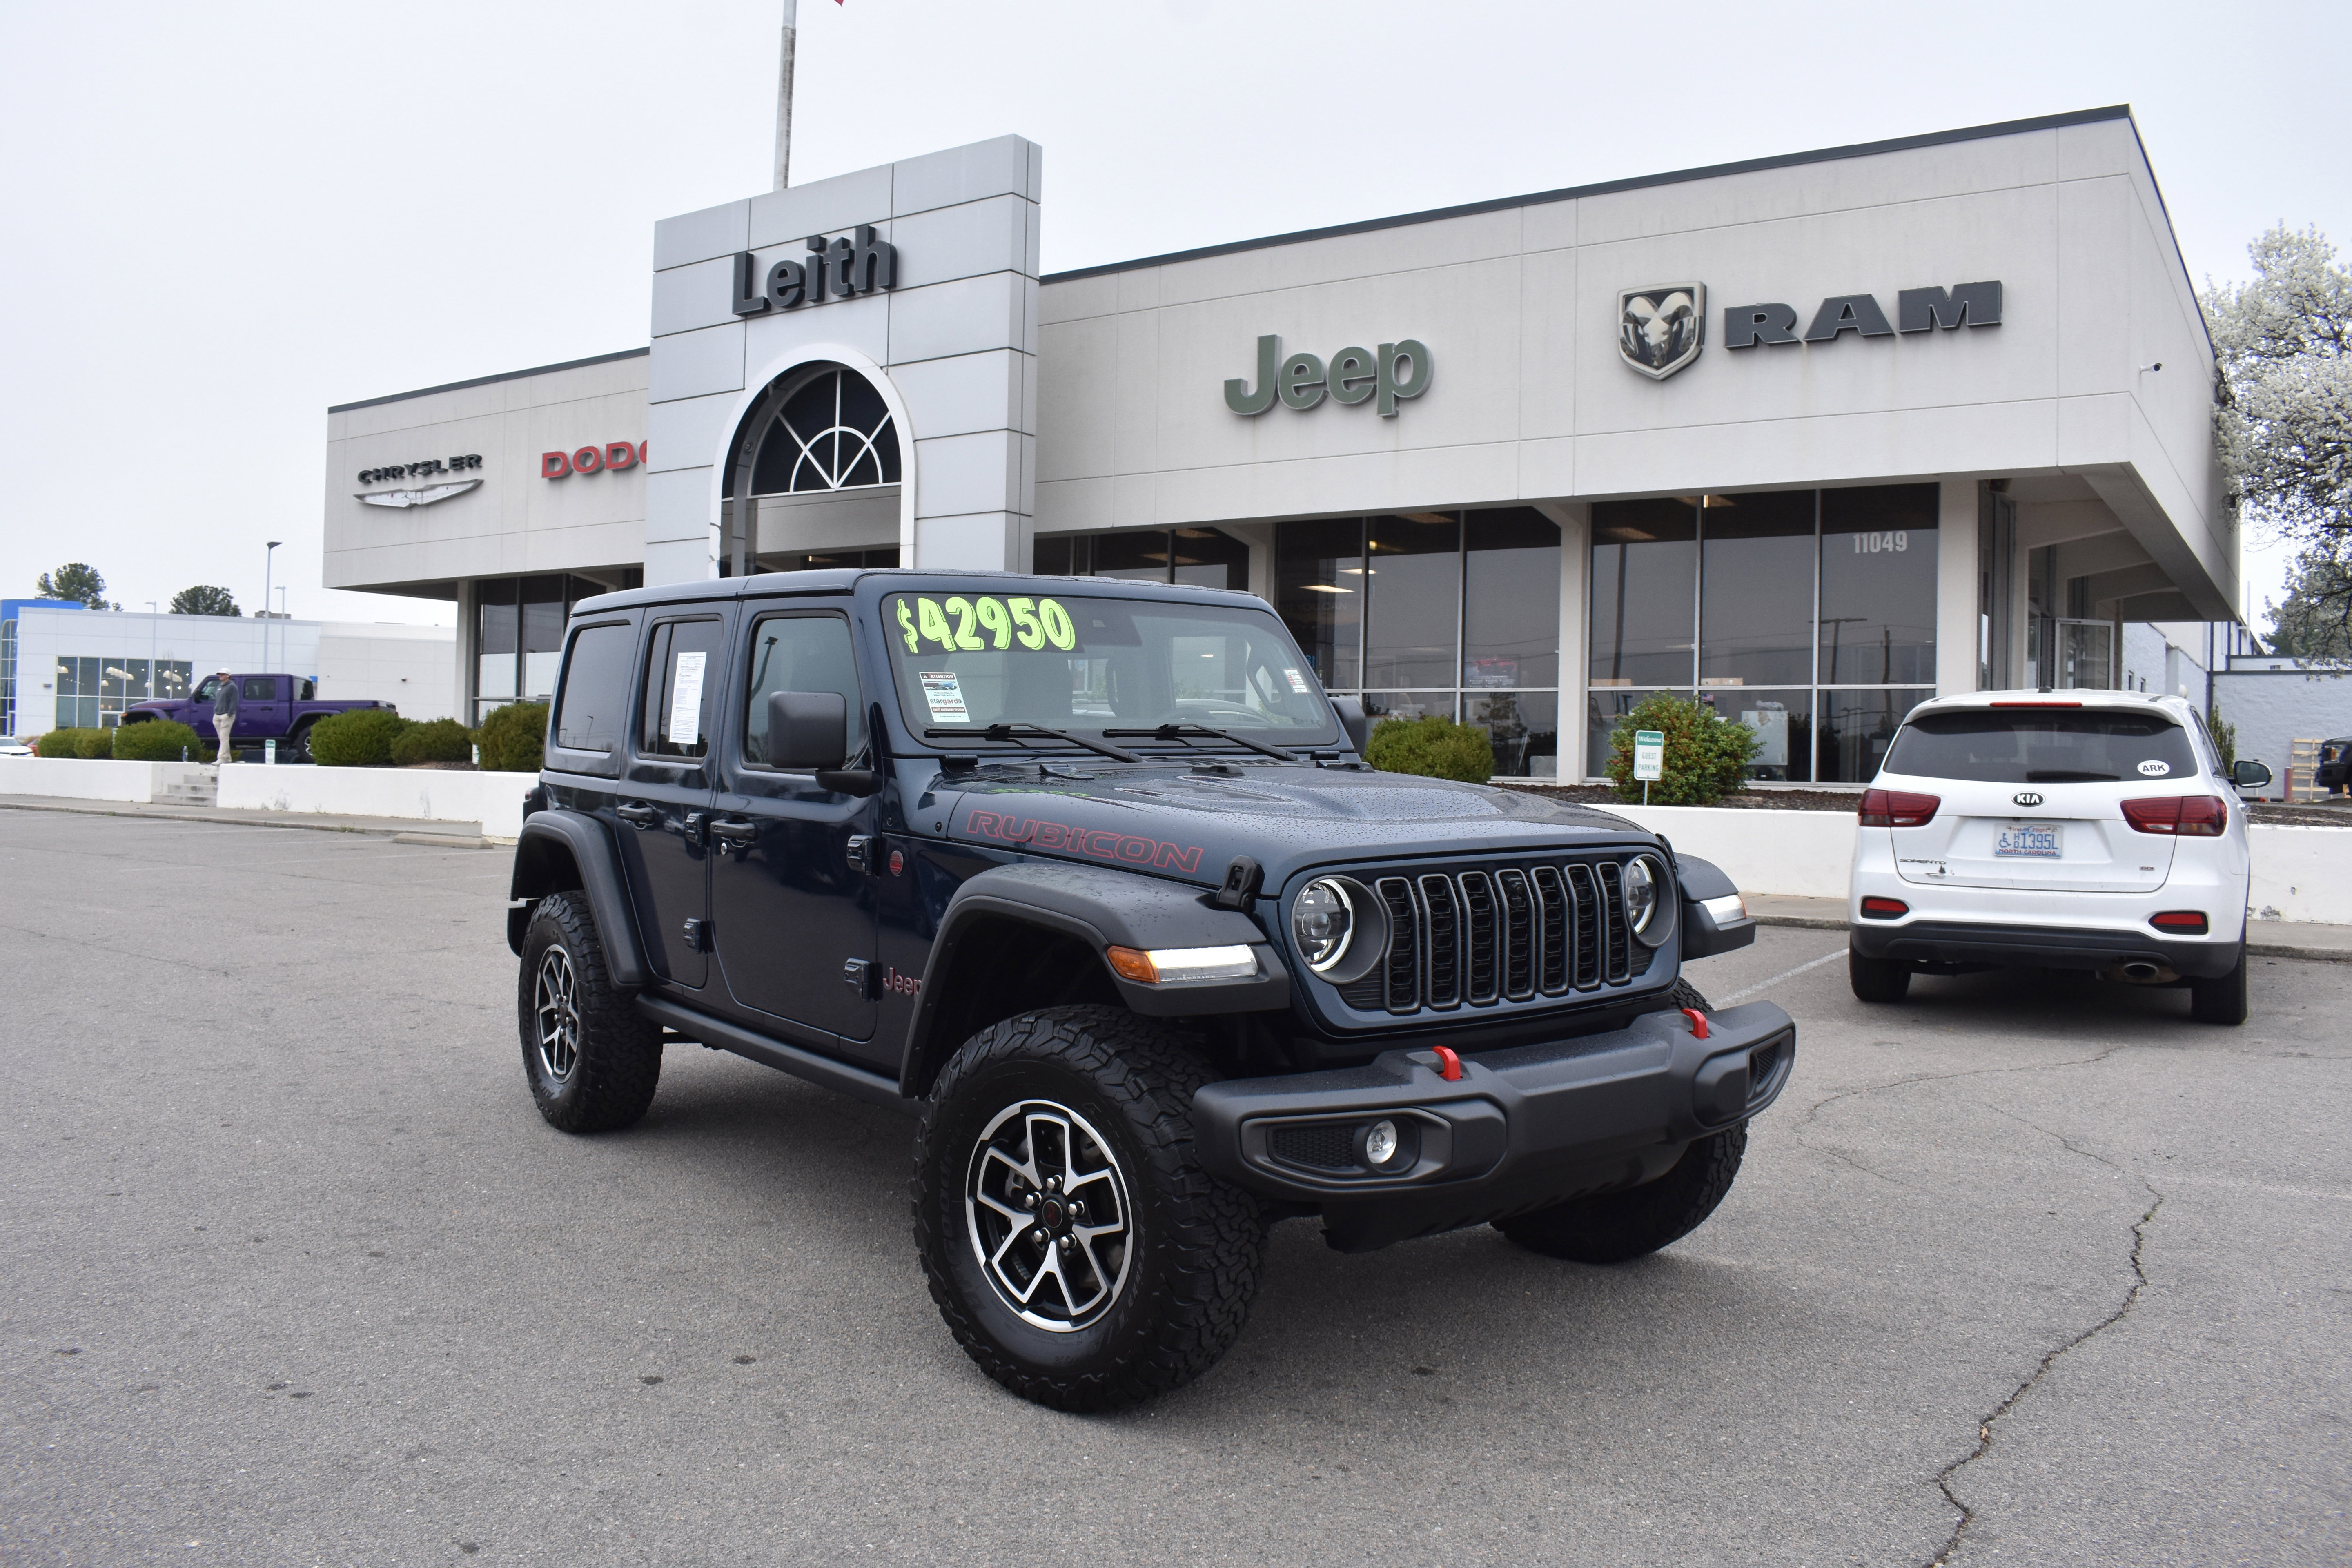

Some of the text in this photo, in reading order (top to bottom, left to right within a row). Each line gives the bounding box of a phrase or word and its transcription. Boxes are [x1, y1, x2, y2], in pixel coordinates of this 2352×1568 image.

[732, 225, 898, 317] Leith
[1724, 279, 2003, 350] RAM
[1224, 334, 1434, 418] Jeep
[358, 454, 483, 483] CHRYSLER
[541, 439, 648, 479] DOD
[1853, 531, 1907, 553] 11049
[897, 596, 1076, 654] $42950
[2017, 794, 2040, 804] KIA
[966, 810, 1204, 873] RUBICON
